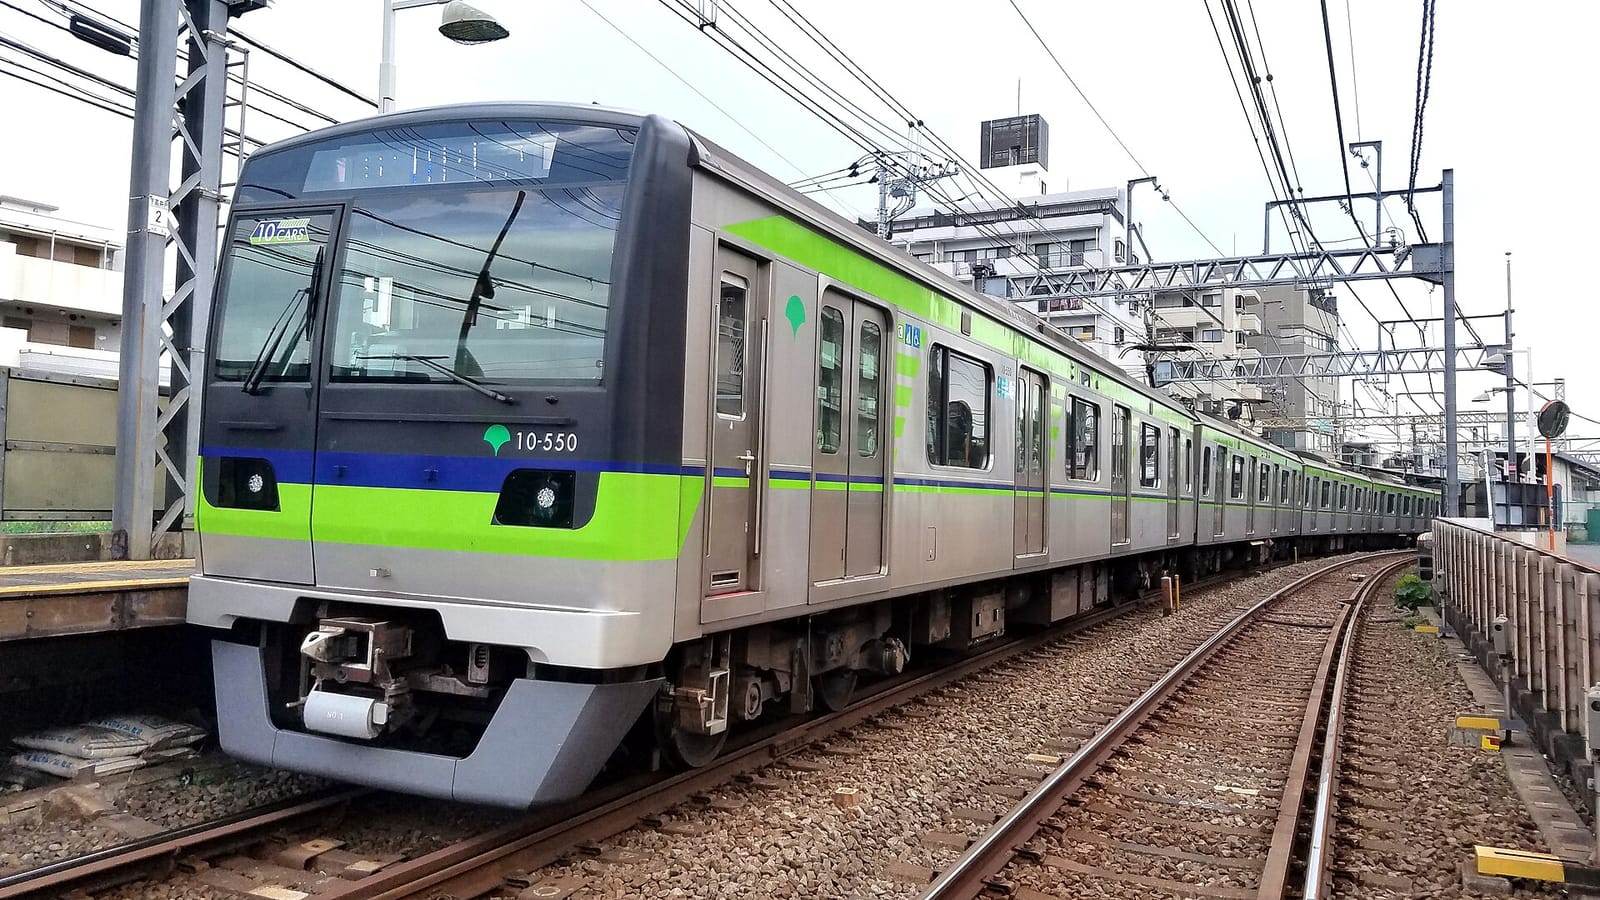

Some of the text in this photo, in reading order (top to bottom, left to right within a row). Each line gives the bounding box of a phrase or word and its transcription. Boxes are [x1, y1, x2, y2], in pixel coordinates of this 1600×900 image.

[155, 210, 162, 223] 2
[258, 222, 305, 242] 10 CARS
[516, 432, 578, 452] 10-550
